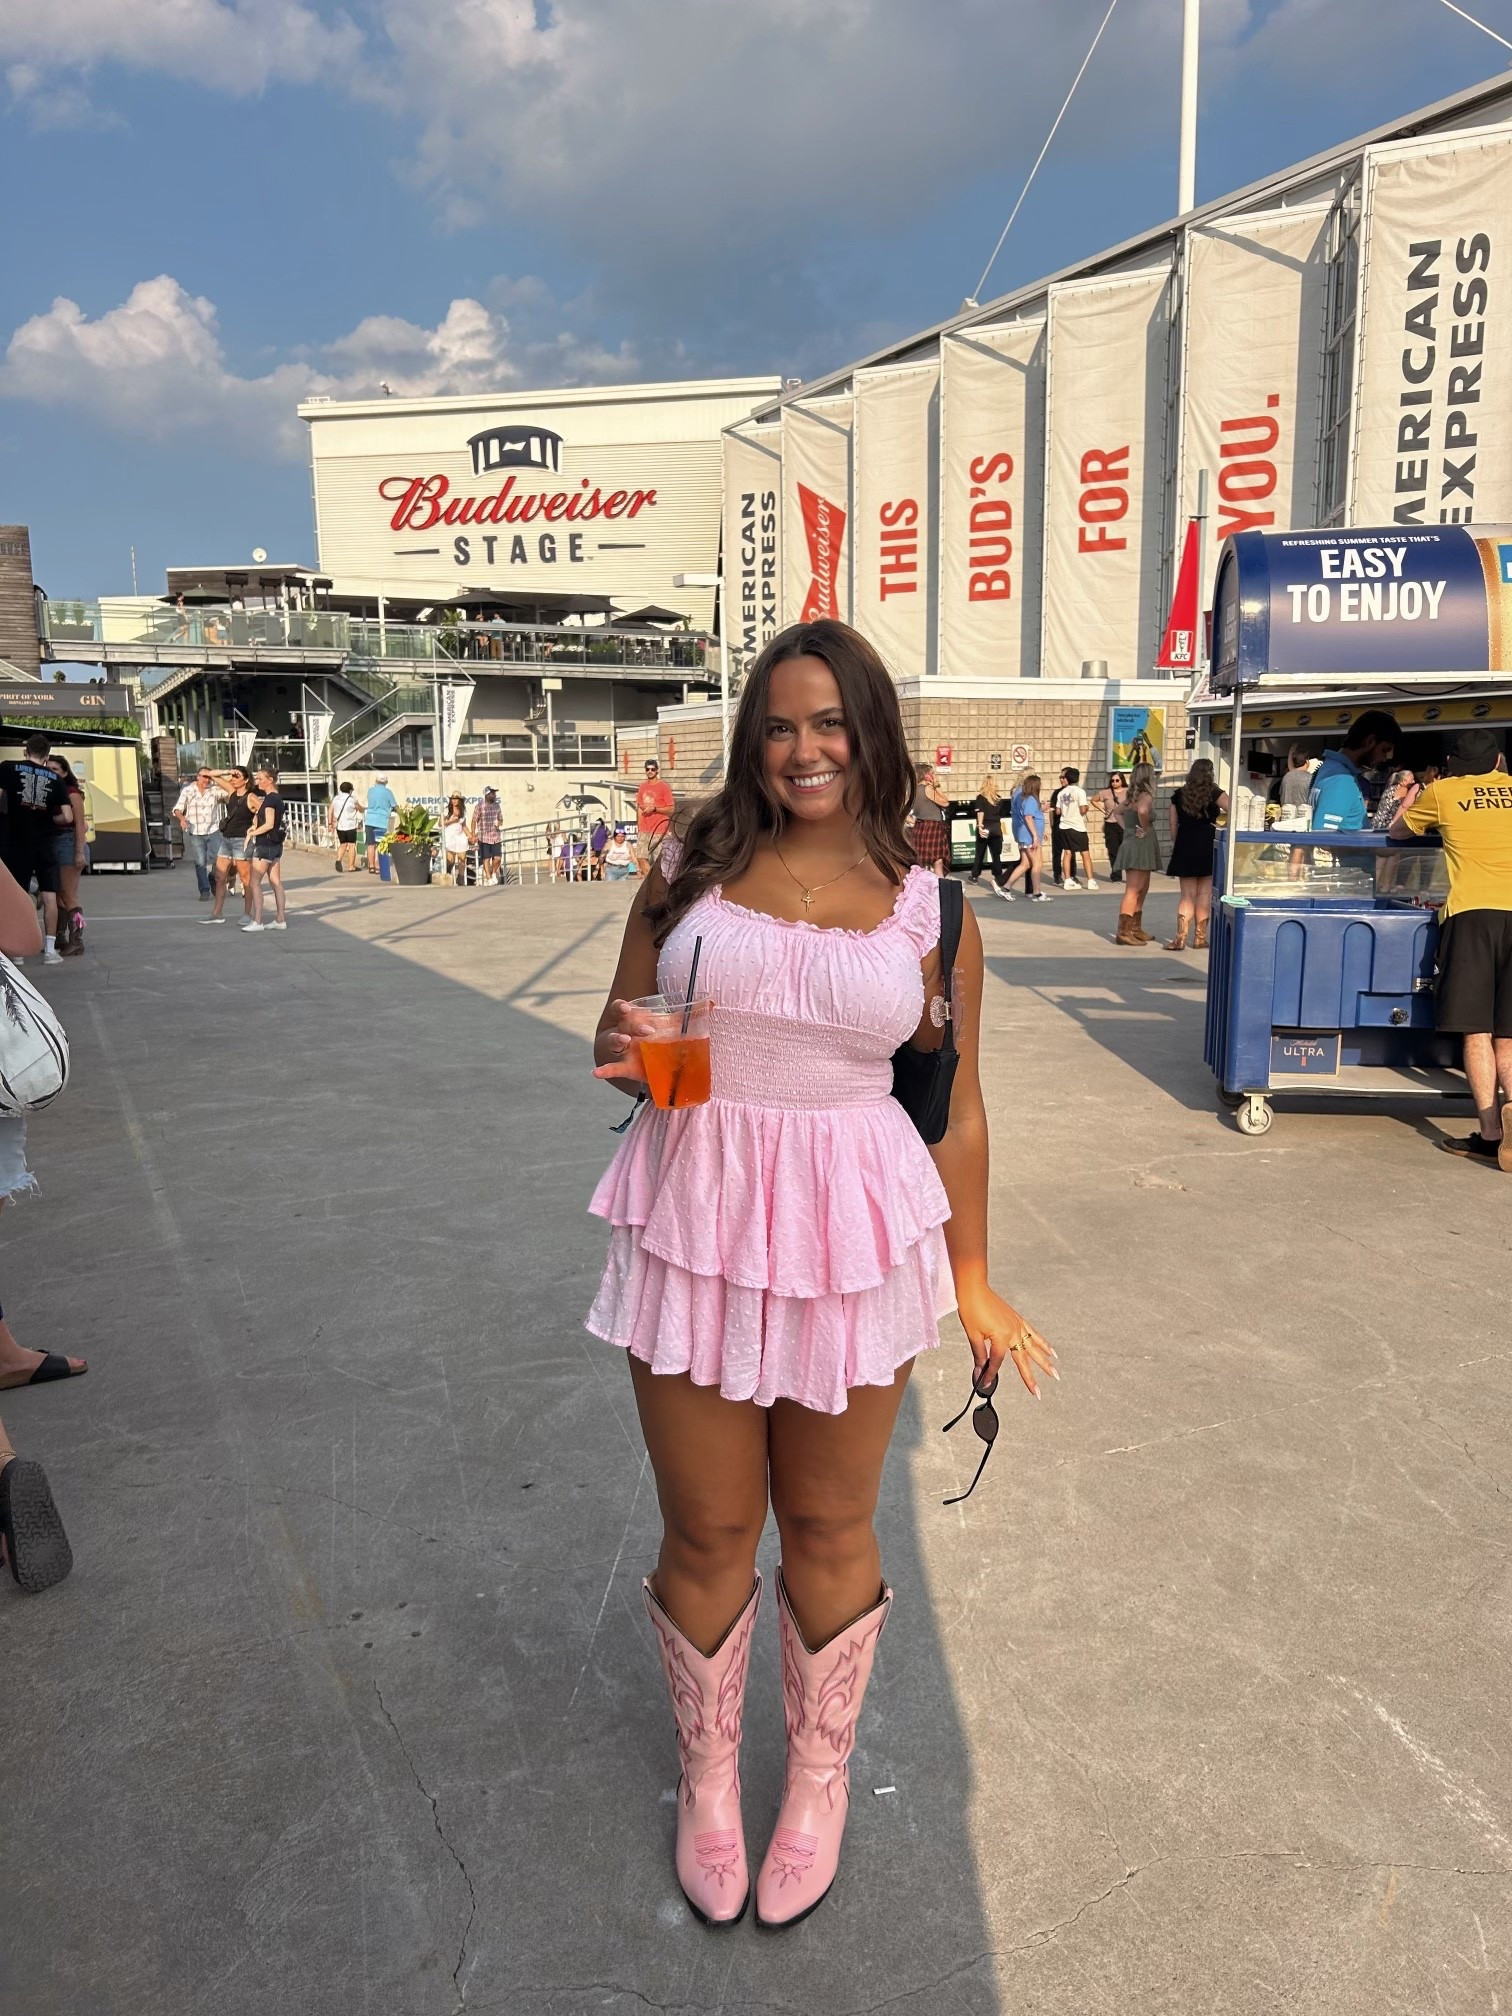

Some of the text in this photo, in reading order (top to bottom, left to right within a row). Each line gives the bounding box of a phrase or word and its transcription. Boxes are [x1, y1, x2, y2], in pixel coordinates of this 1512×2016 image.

[1217, 394, 1279, 541] YOU.
[379, 474, 657, 531] Budweiser
[1078, 445, 1130, 553] FOR
[969, 452, 1014, 602] BUD'S
[1282, 538, 1337, 546] REFRESHING
[1338, 537, 1377, 545] SUMMER
[1408, 535, 1441, 543] THAT'S
[454, 533, 584, 565] STAGE
[762, 490, 776, 647] EXPRESS
[880, 498, 918, 601] THIS
[1320, 547, 1407, 579] EASY
[741, 493, 757, 675] AMERICAN
[1287, 581, 1447, 623] TO ENJOY
[80, 695, 106, 706] GIN
[1457, 798, 1512, 812] VEND
[624, 825, 638, 834] CUT
[1283, 1047, 1324, 1057] ULTRA
